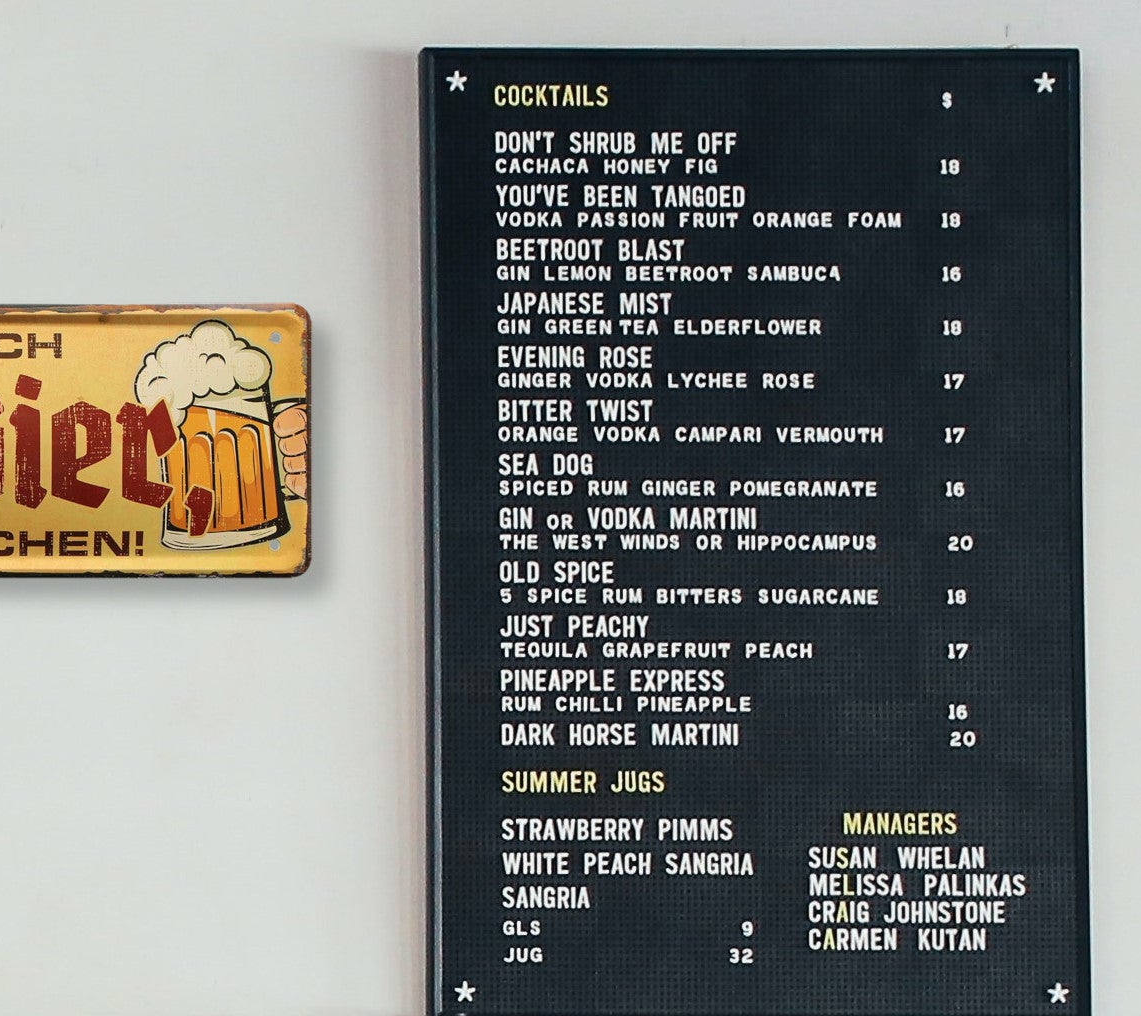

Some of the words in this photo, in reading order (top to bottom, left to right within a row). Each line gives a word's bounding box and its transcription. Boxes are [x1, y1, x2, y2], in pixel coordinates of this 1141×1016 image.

[494, 84, 608, 106] COCKTAILS
[494, 130, 554, 153] DON'T
[569, 131, 635, 154] SHRUB
[650, 131, 682, 154] ME
[697, 131, 736, 154] OFF
[495, 157, 588, 174] CACHACA
[603, 158, 670, 174] HONEY
[685, 158, 717, 174] FIG
[940, 158, 959, 175] 18
[495, 183, 568, 207] YOU'VE
[583, 184, 636, 207] BEEN
[650, 184, 745, 208] TANGOED
[495, 211, 562, 227] VODKA
[577, 211, 664, 227] PASSION
[679, 211, 738, 228] FRUIT
[752, 211, 832, 228] ORANGE
[848, 211, 901, 228] FOAM
[941, 212, 960, 228] 18
[496, 238, 603, 261] BEETROOT
[618, 238, 684, 261] BLAST
[496, 265, 529, 281] GIN
[544, 265, 611, 281] LEMON
[625, 265, 732, 281] BEETROOT
[941, 266, 961, 282] 16
[496, 291, 604, 314] JAPANESE
[619, 292, 671, 315] MIST
[497, 318, 530, 334] GIN
[544, 318, 613, 335] GREEN
[617, 318, 658, 335] TEA
[673, 318, 821, 335] ELDERFLOWER
[942, 319, 961, 335] 18
[497, 345, 584, 368] EVENING
[599, 345, 652, 369] ROSE
[497, 372, 571, 388] GINGER
[585, 372, 652, 388] VODKA
[667, 372, 747, 388] LYCHEE
[762, 372, 814, 389] ROSE
[943, 373, 964, 389] 17
[498, 399, 572, 422] BITTER
[585, 399, 652, 422] TWIST
[497, 425, 577, 442] ORANGE
[593, 425, 660, 442] VODKA
[674, 426, 761, 442] CAMPARI
[776, 426, 883, 443] VERMOUTH
[944, 427, 965, 443] 17
[498, 453, 538, 475] SEA
[552, 453, 593, 475] DOG
[499, 479, 573, 496] SPICED
[587, 480, 627, 496] RUM
[641, 479, 715, 496] GINGER
[729, 480, 877, 497] POMEGRANATE
[945, 480, 964, 497] 16
[499, 506, 532, 529] GIN
[546, 513, 573, 530] OR
[586, 506, 655, 529] VODKA
[669, 506, 756, 530] MARTINI
[499, 533, 538, 550] THE
[552, 533, 607, 550] WEST
[619, 533, 679, 550] WINDS
[695, 534, 722, 550] OR
[737, 534, 876, 551] HIPPOCAMPUS
[947, 535, 973, 551] 20
[499, 560, 539, 583] OLD
[553, 560, 613, 583] SPICE
[499, 587, 511, 603] 5
[527, 587, 586, 604] SPICE
[602, 587, 642, 604] RUM
[656, 587, 741, 604] BITTERS
[758, 588, 878, 605] SUGARCANE
[947, 588, 966, 604] 18
[499, 614, 553, 637] JUST
[567, 614, 648, 638] PEACHY
[500, 641, 587, 658] TEQUILA
[602, 641, 730, 658] GRAPEFRUIT
[745, 642, 812, 658] PEACH
[947, 643, 968, 659] 17
[500, 668, 615, 692] PINEAPPLE
[630, 669, 724, 692] EXPRESS
[501, 695, 541, 711] RUM
[555, 695, 622, 712] CHILLI
[637, 695, 751, 712] PINEAPPLE
[947, 703, 967, 720] 16
[501, 722, 554, 746] DARK
[569, 722, 636, 746] HORSE
[651, 722, 738, 746] MARTINI
[949, 730, 976, 747] 20
[501, 770, 596, 793] SUMMER
[610, 770, 664, 792] JUGS
[501, 817, 643, 841] STRAWBERRY
[658, 818, 733, 841] PIMMS
[843, 812, 957, 835] MANAGERS
[502, 851, 569, 875] WHITE
[583, 851, 651, 875] PEACH
[665, 852, 753, 875] SANGRIA
[808, 845, 876, 869] SUSAN
[897, 846, 984, 869] WHELAN
[809, 873, 903, 896] MELISSA
[924, 873, 1026, 897] PALINKAS
[502, 885, 590, 909] SANGRIA
[808, 900, 869, 923] CRAIG
[883, 900, 1005, 923] JOHNSTONE
[502, 920, 540, 935] GLS
[741, 920, 753, 936] 9
[808, 927, 897, 950] CARMEN
[918, 927, 985, 951] KUTAN
[503, 946, 542, 962] JUG
[729, 947, 753, 963] 32
